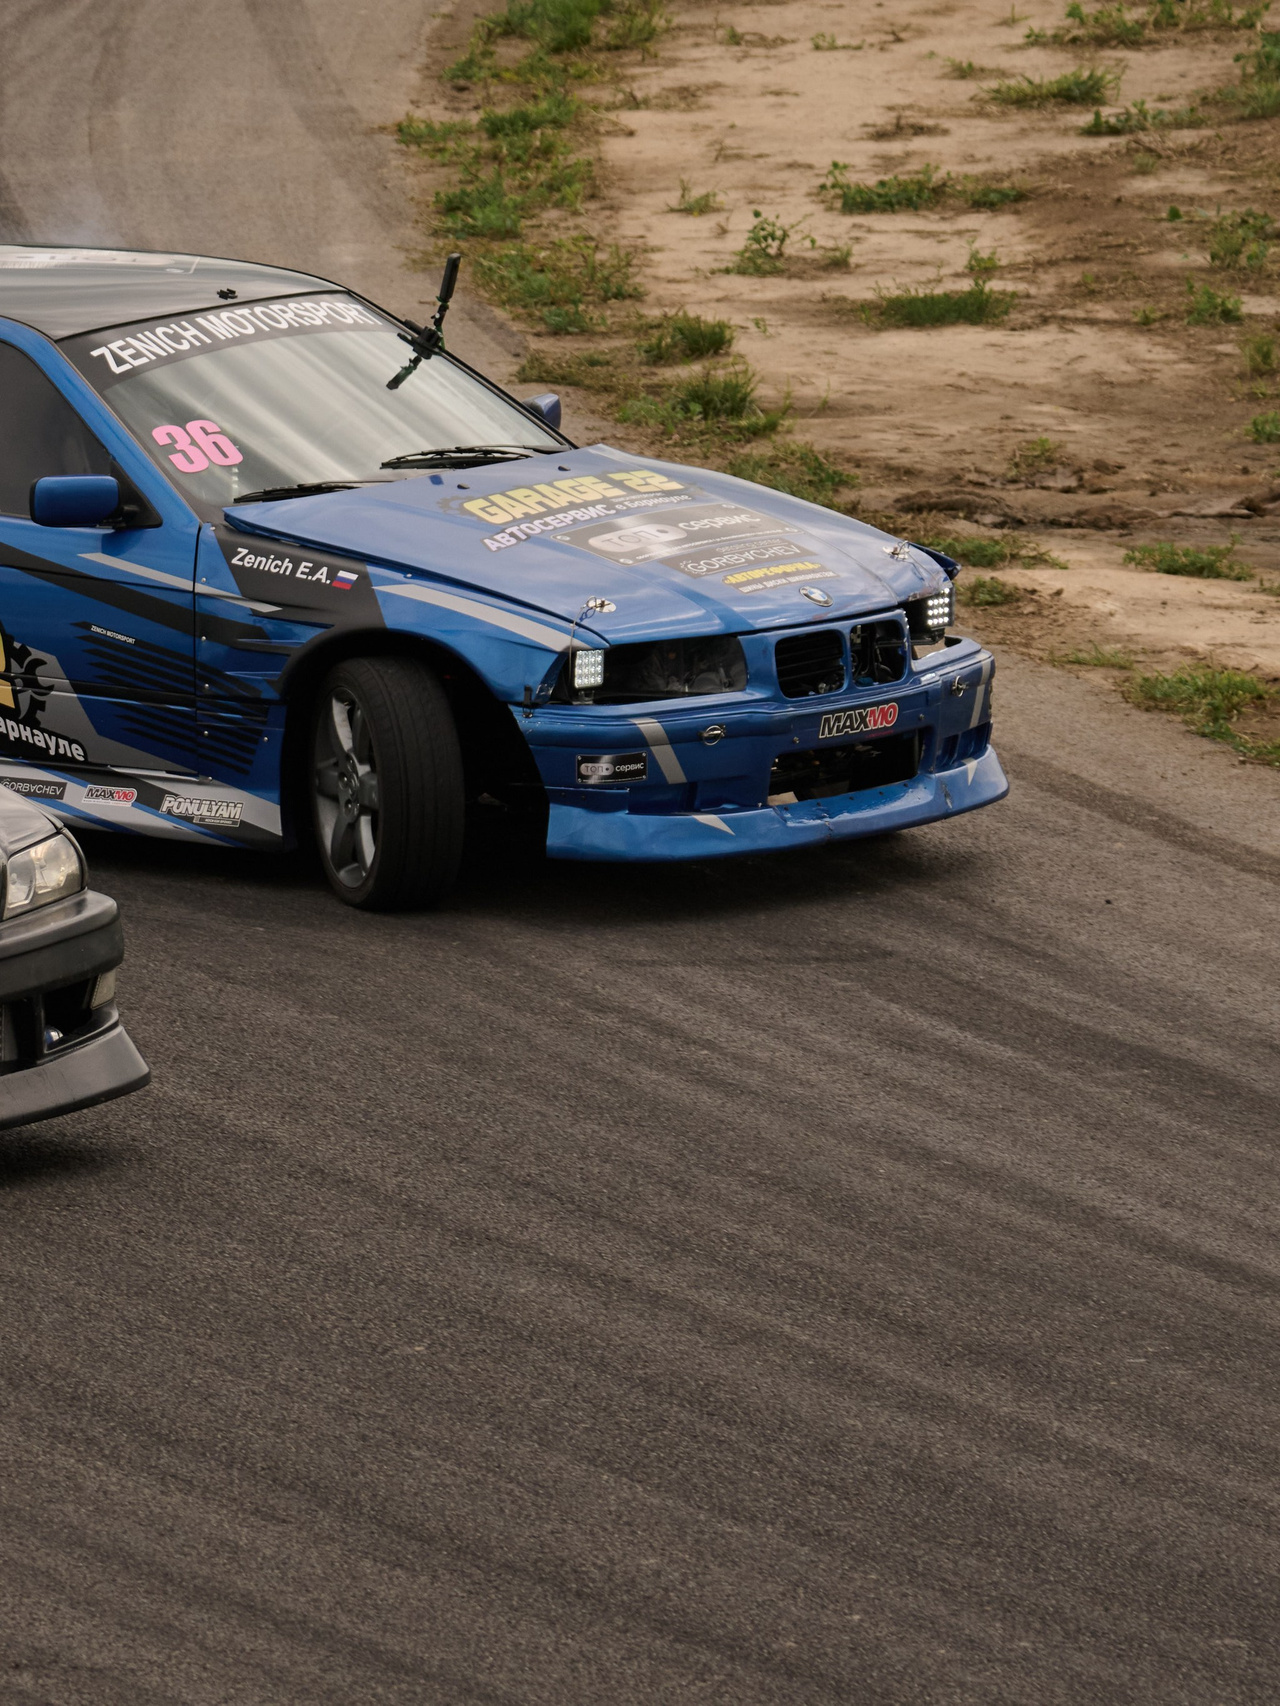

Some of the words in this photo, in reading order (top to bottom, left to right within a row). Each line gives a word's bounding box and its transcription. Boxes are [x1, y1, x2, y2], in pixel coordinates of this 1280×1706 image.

[90, 320, 209, 375] ZENICH
[195, 301, 384, 341] MOTORSPORT
[151, 419, 243, 474] 36
[462, 475, 626, 525] GARAGE
[608, 469, 685, 494] 22
[483, 504, 617, 552] АВТОСЕРВИС
[624, 494, 692, 508] Барнауле
[601, 530, 658, 549] ТОП
[678, 514, 761, 531] сервис
[231, 547, 294, 576] Zenich
[295, 561, 332, 584] E.A.
[90, 624, 107, 635] ZENICH
[106, 630, 136, 645] MOTORSPORT
[818, 702, 899, 739] MAXMO
[584, 765, 604, 773] ТОП
[615, 762, 645, 772] сервис
[85, 786, 136, 802] MAXMO
[161, 795, 243, 820] PONULYAM
